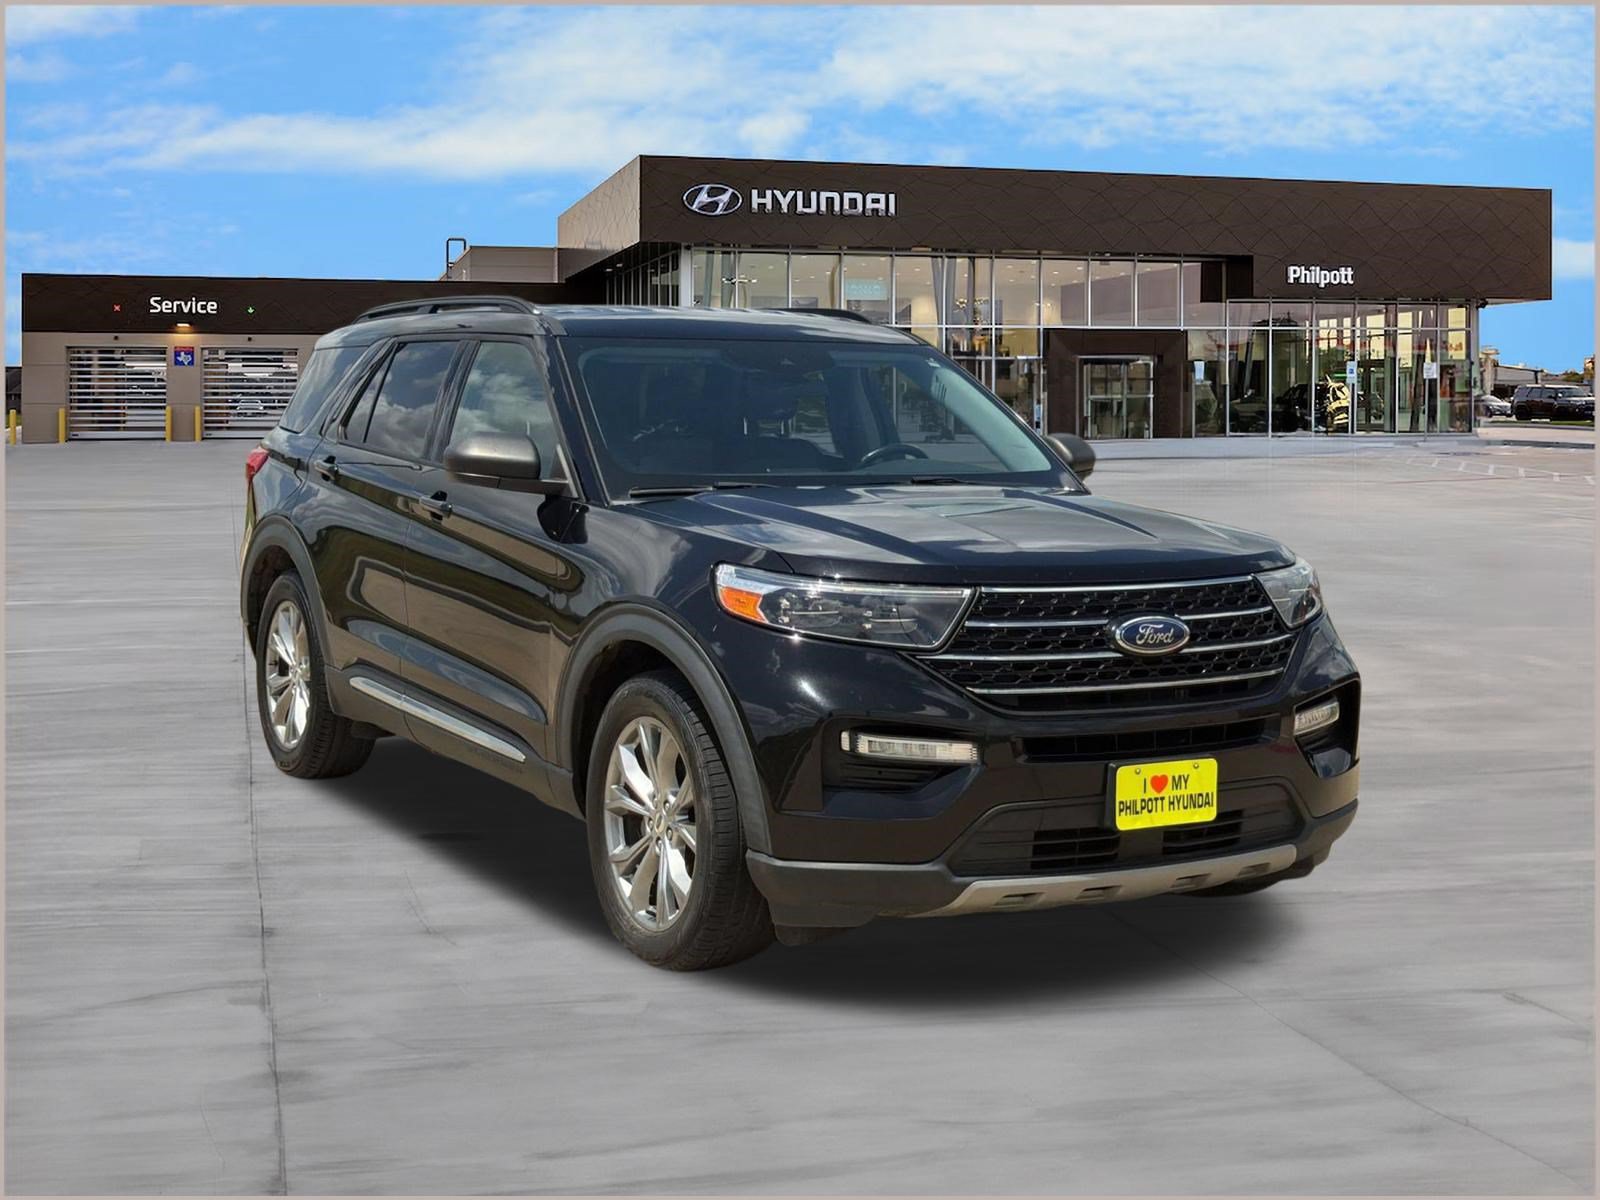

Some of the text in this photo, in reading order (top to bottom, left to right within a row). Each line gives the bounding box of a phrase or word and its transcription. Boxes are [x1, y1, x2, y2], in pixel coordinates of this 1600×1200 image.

[751, 189, 896, 216] HYUNDAI
[1287, 265, 1354, 288] Philpott
[149, 297, 218, 314] Service
[1135, 623, 1174, 645] Ford
[1171, 774, 1190, 791] MY
[1118, 792, 1214, 816] PHILPOTT HYUNDAI
